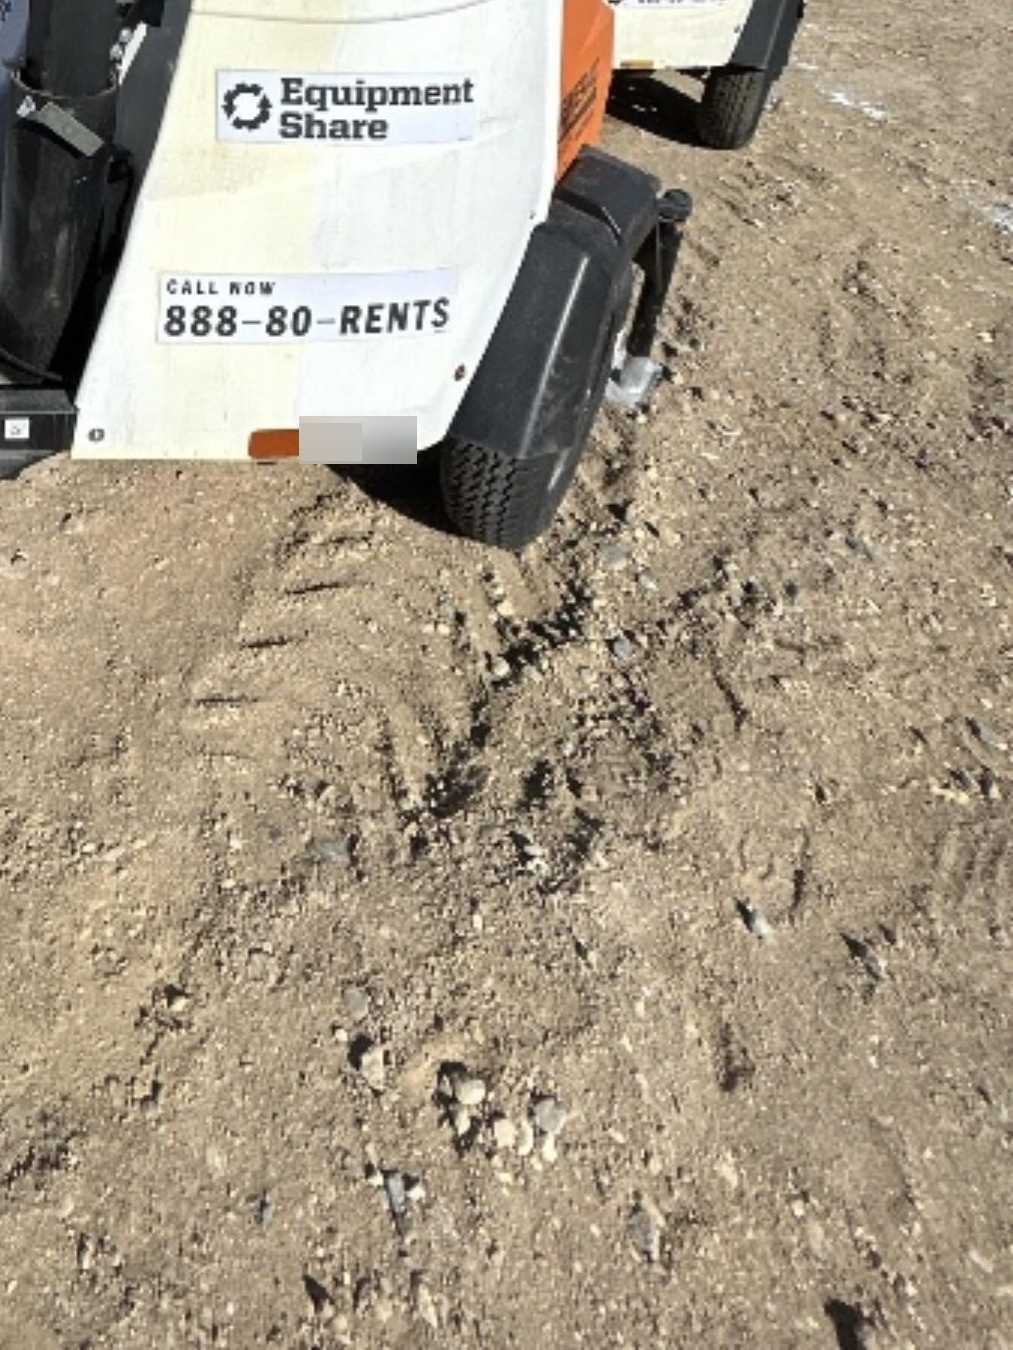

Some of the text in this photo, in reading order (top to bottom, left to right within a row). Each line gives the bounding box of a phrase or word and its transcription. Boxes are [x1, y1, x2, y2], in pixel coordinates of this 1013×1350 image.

[280, 77, 475, 112] Equipment
[279, 111, 390, 140] Share
[166, 279, 276, 296] CALL NOW
[163, 297, 451, 337] 888-80-RENTS
